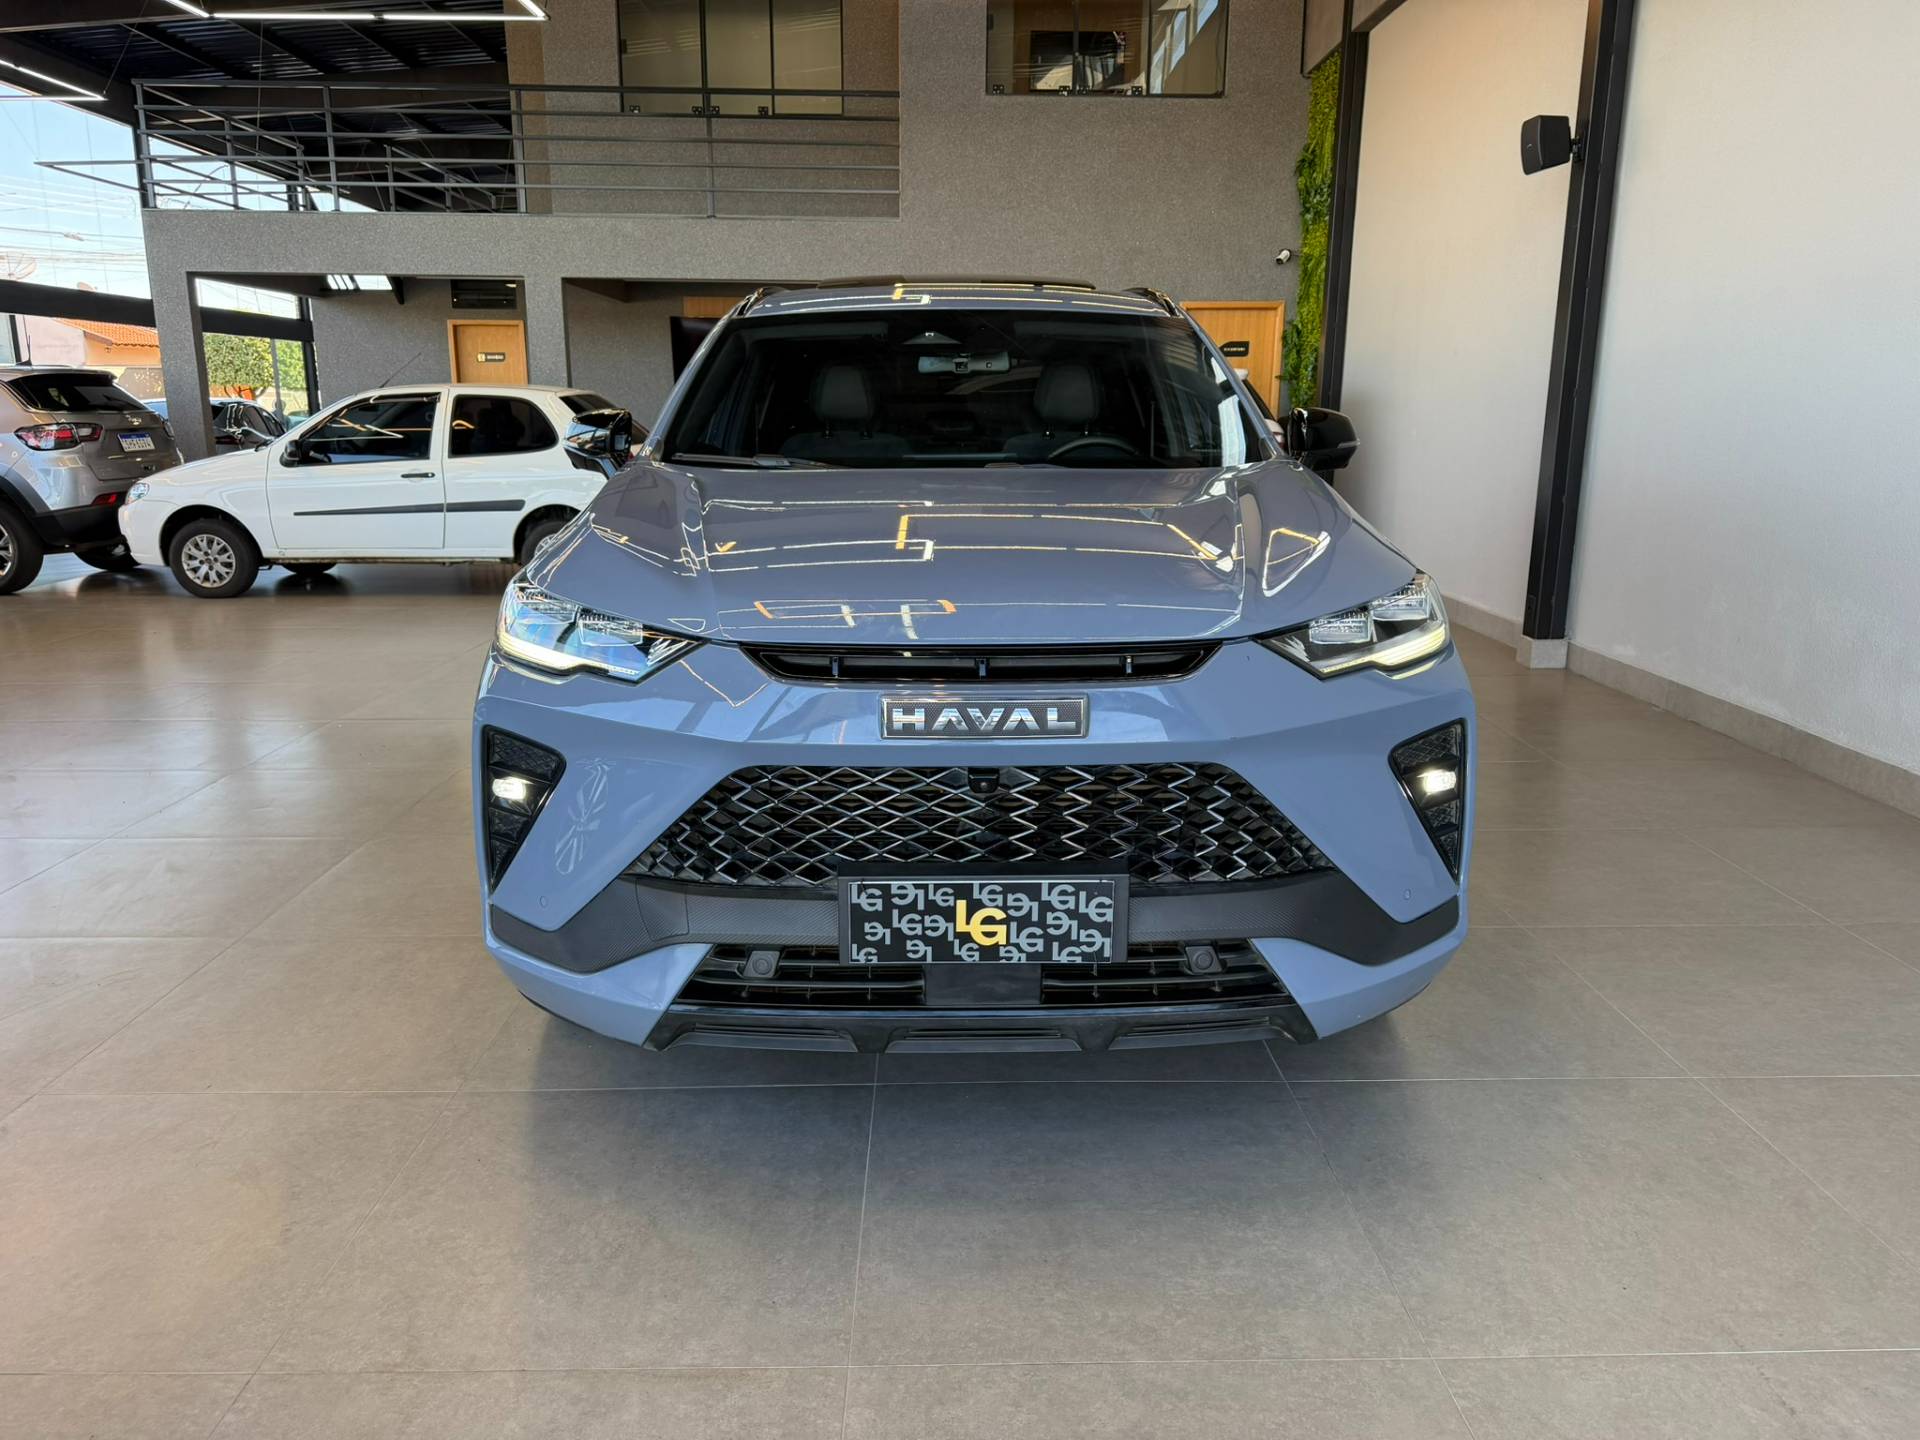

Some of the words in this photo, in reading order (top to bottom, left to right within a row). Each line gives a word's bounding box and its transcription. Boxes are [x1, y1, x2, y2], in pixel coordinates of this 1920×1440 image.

[893, 708, 1076, 730] HAVAL
[851, 884, 882, 911] LG
[928, 884, 954, 906] LG
[973, 883, 1003, 906] LG
[1042, 882, 1075, 910] LG
[1079, 891, 1113, 922] LG
[893, 909, 922, 935] LG
[956, 900, 1006, 946] LG
[1010, 922, 1043, 952] LG
[852, 944, 877, 962] LG
[954, 939, 979, 962] LG
[1053, 942, 1082, 962] LG
